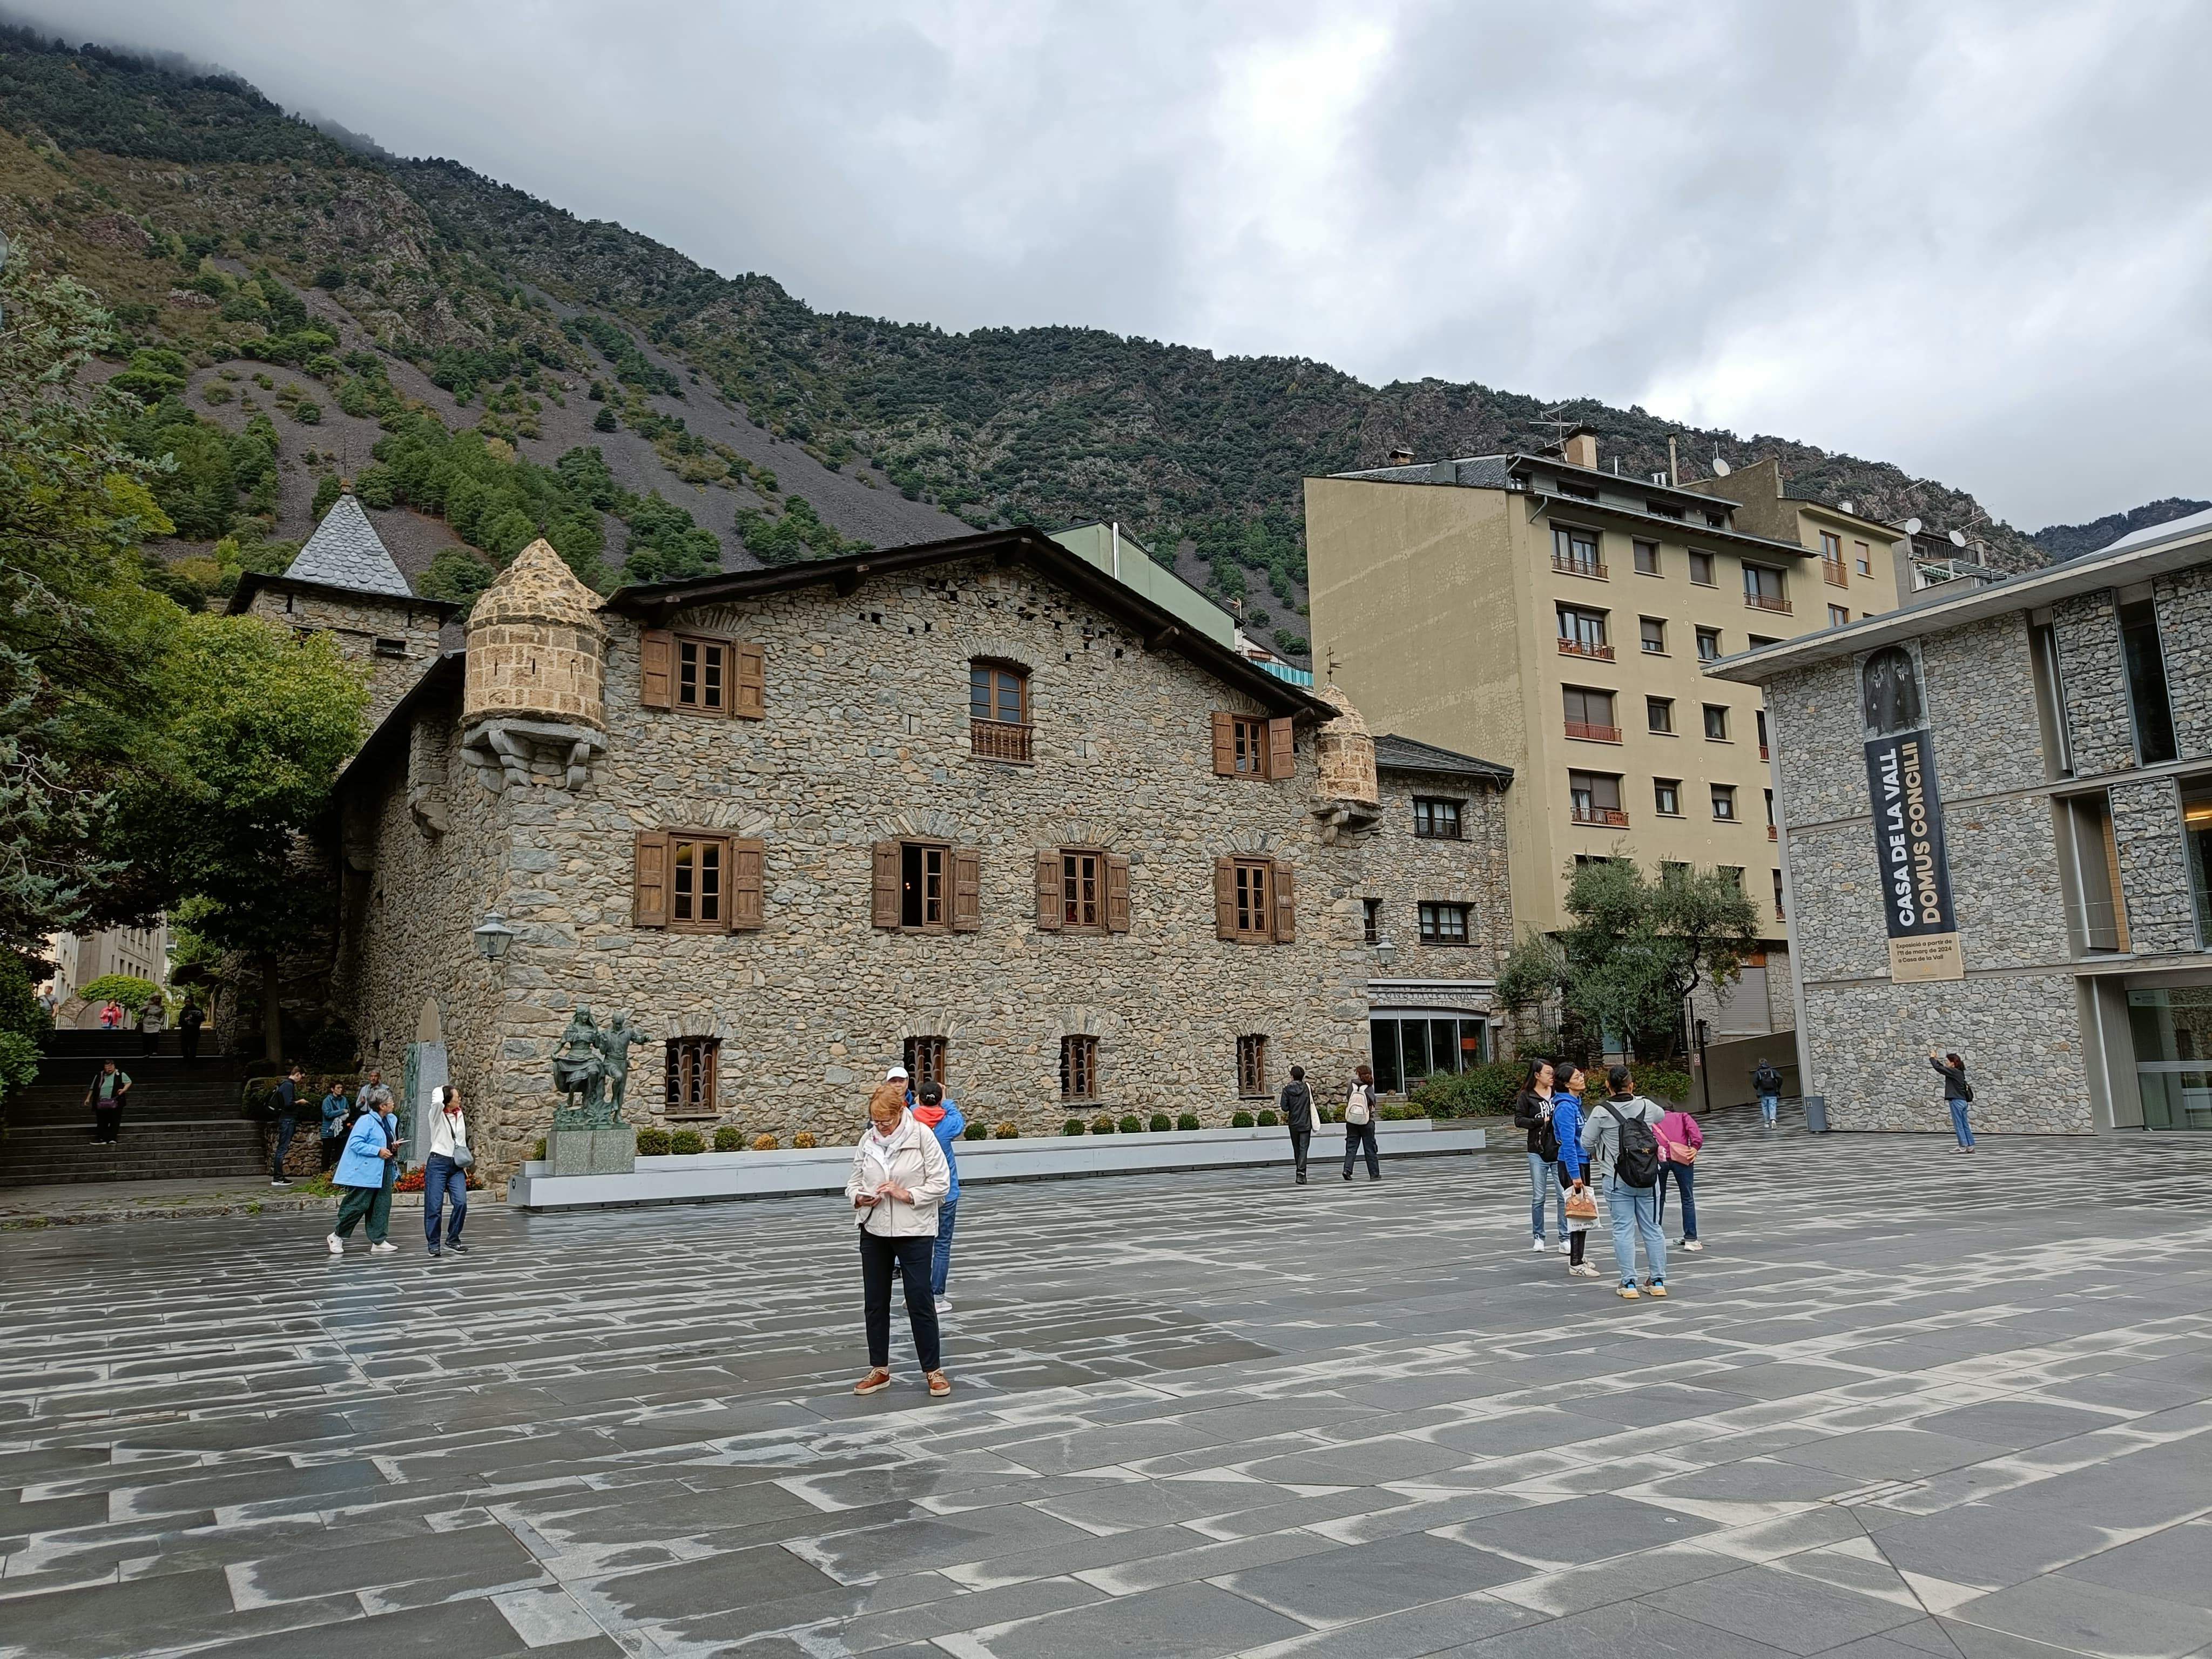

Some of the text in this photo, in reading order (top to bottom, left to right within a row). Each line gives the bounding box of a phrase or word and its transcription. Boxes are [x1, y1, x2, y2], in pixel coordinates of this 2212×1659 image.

[1879, 748, 1915, 927] CASA DE LA VALL
[1902, 741, 1941, 925] DOMUS CONCILII
[1896, 941, 1921, 949] Exposició
